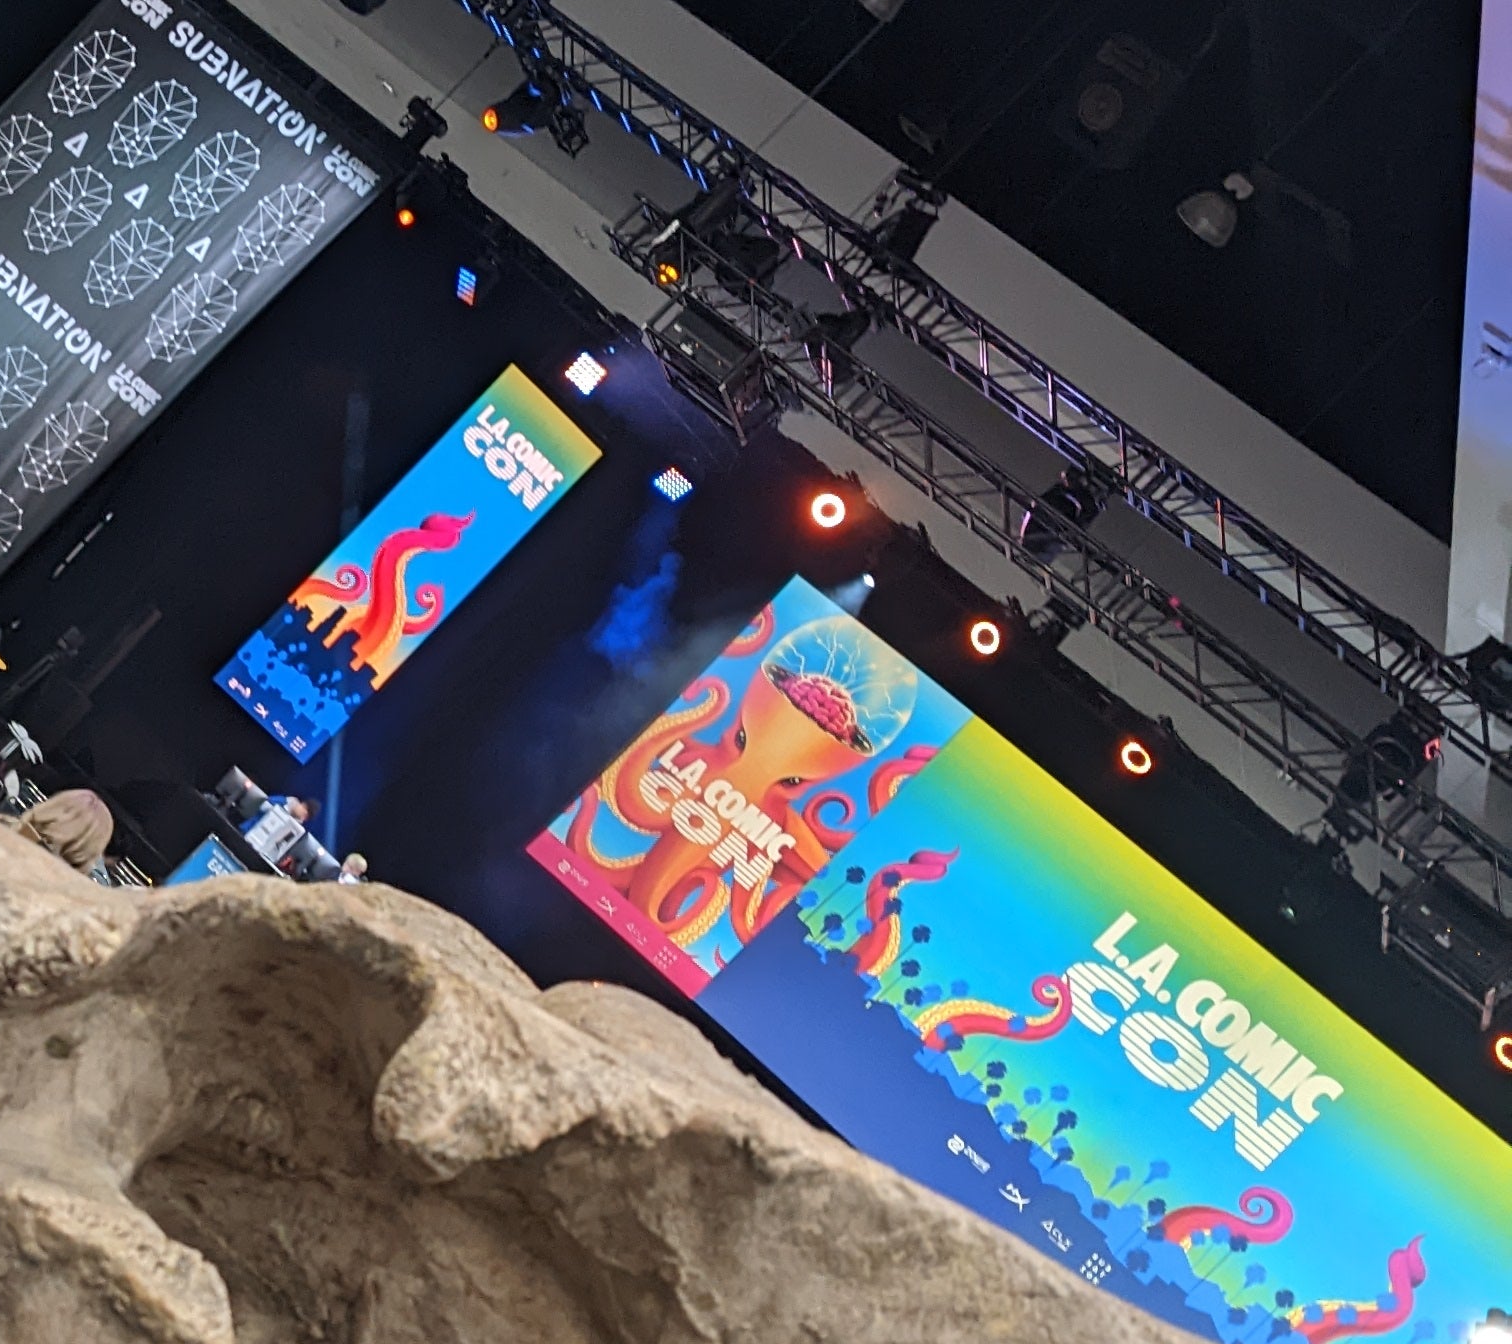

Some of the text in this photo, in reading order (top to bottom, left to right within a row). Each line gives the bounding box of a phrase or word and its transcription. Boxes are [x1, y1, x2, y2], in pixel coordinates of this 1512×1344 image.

[168, 20, 328, 156] SUBNATION
[323, 155, 373, 198] CON
[107, 374, 153, 417] CON
[463, 425, 548, 512] CON
[639, 770, 774, 892] CON
[703, 779, 797, 863] COMIC
[1061, 961, 1305, 1172] CON
[1175, 979, 1345, 1125] COMIC
